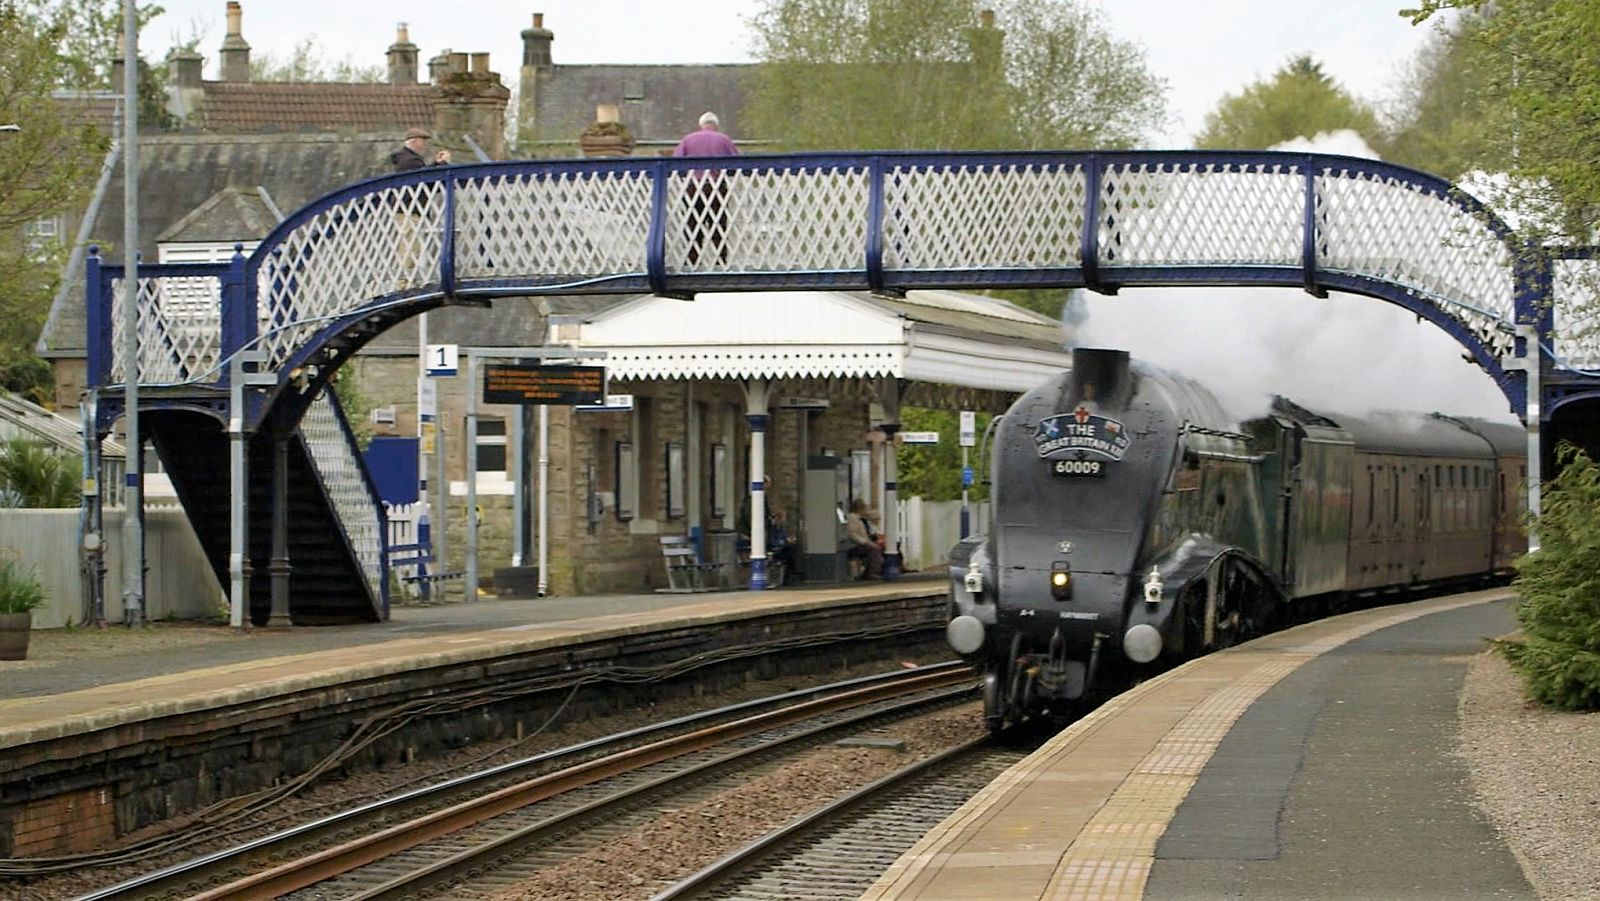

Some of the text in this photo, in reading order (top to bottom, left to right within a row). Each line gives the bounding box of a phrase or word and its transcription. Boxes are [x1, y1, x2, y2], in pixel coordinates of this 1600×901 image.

[436, 347, 448, 367] 1
[1066, 424, 1096, 436] THE
[1040, 437, 1069, 453] GREAT
[1071, 436, 1109, 450] BRITAIN
[1056, 461, 1100, 474] 60009
